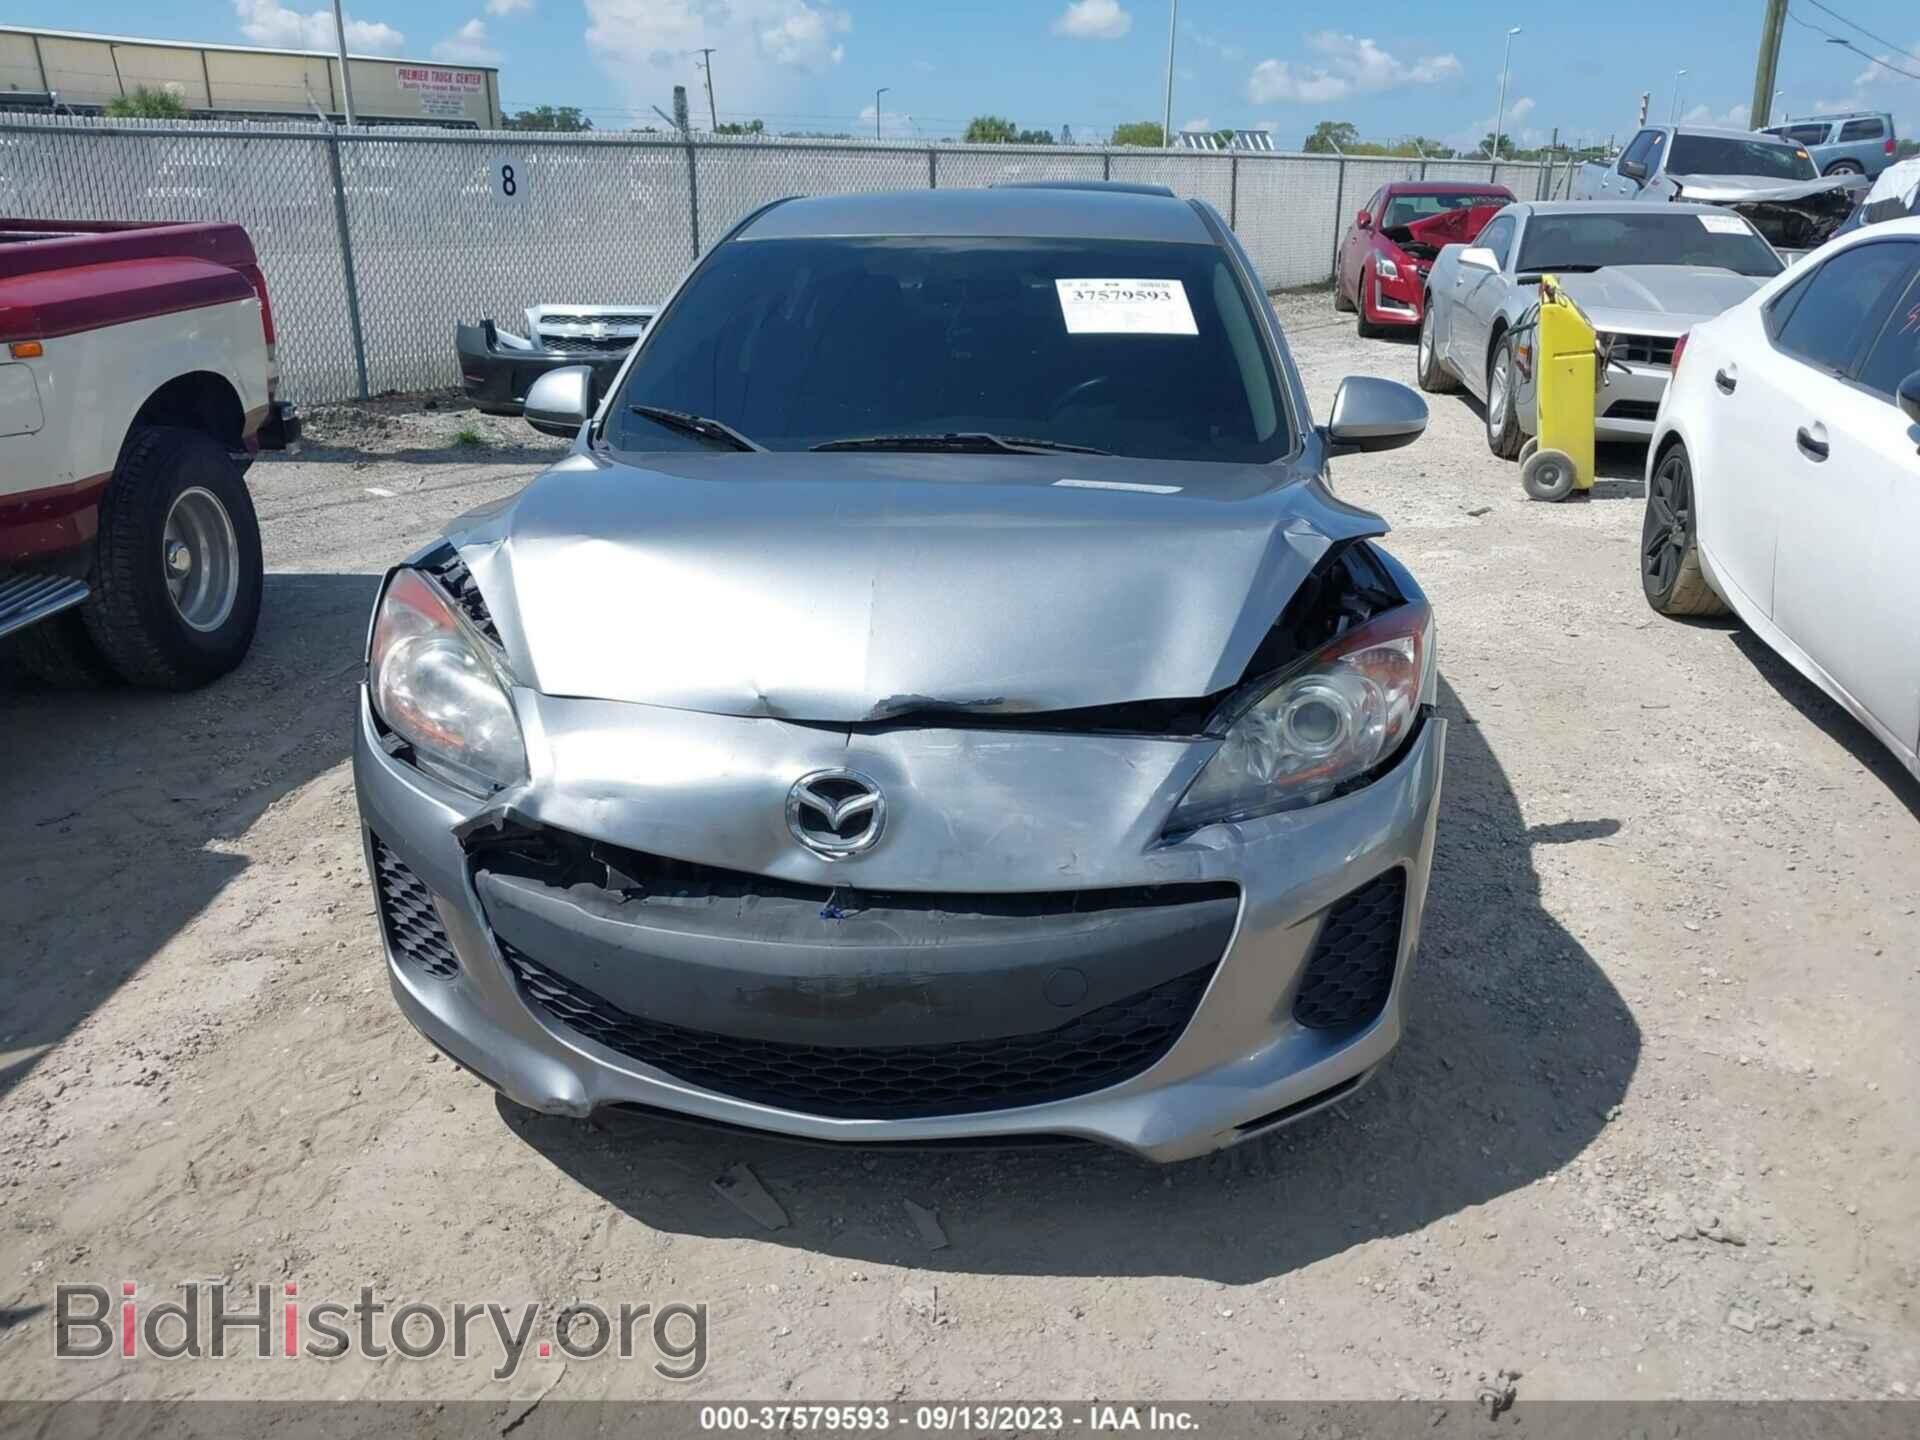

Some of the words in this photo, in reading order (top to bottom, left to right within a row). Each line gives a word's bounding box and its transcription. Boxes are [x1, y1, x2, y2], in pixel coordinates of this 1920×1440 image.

[399, 69, 429, 81] PREMIER
[432, 71, 453, 83] TRUCK
[456, 73, 481, 84] CENTER
[502, 164, 517, 196] 8
[1073, 289, 1172, 301] 37579593
